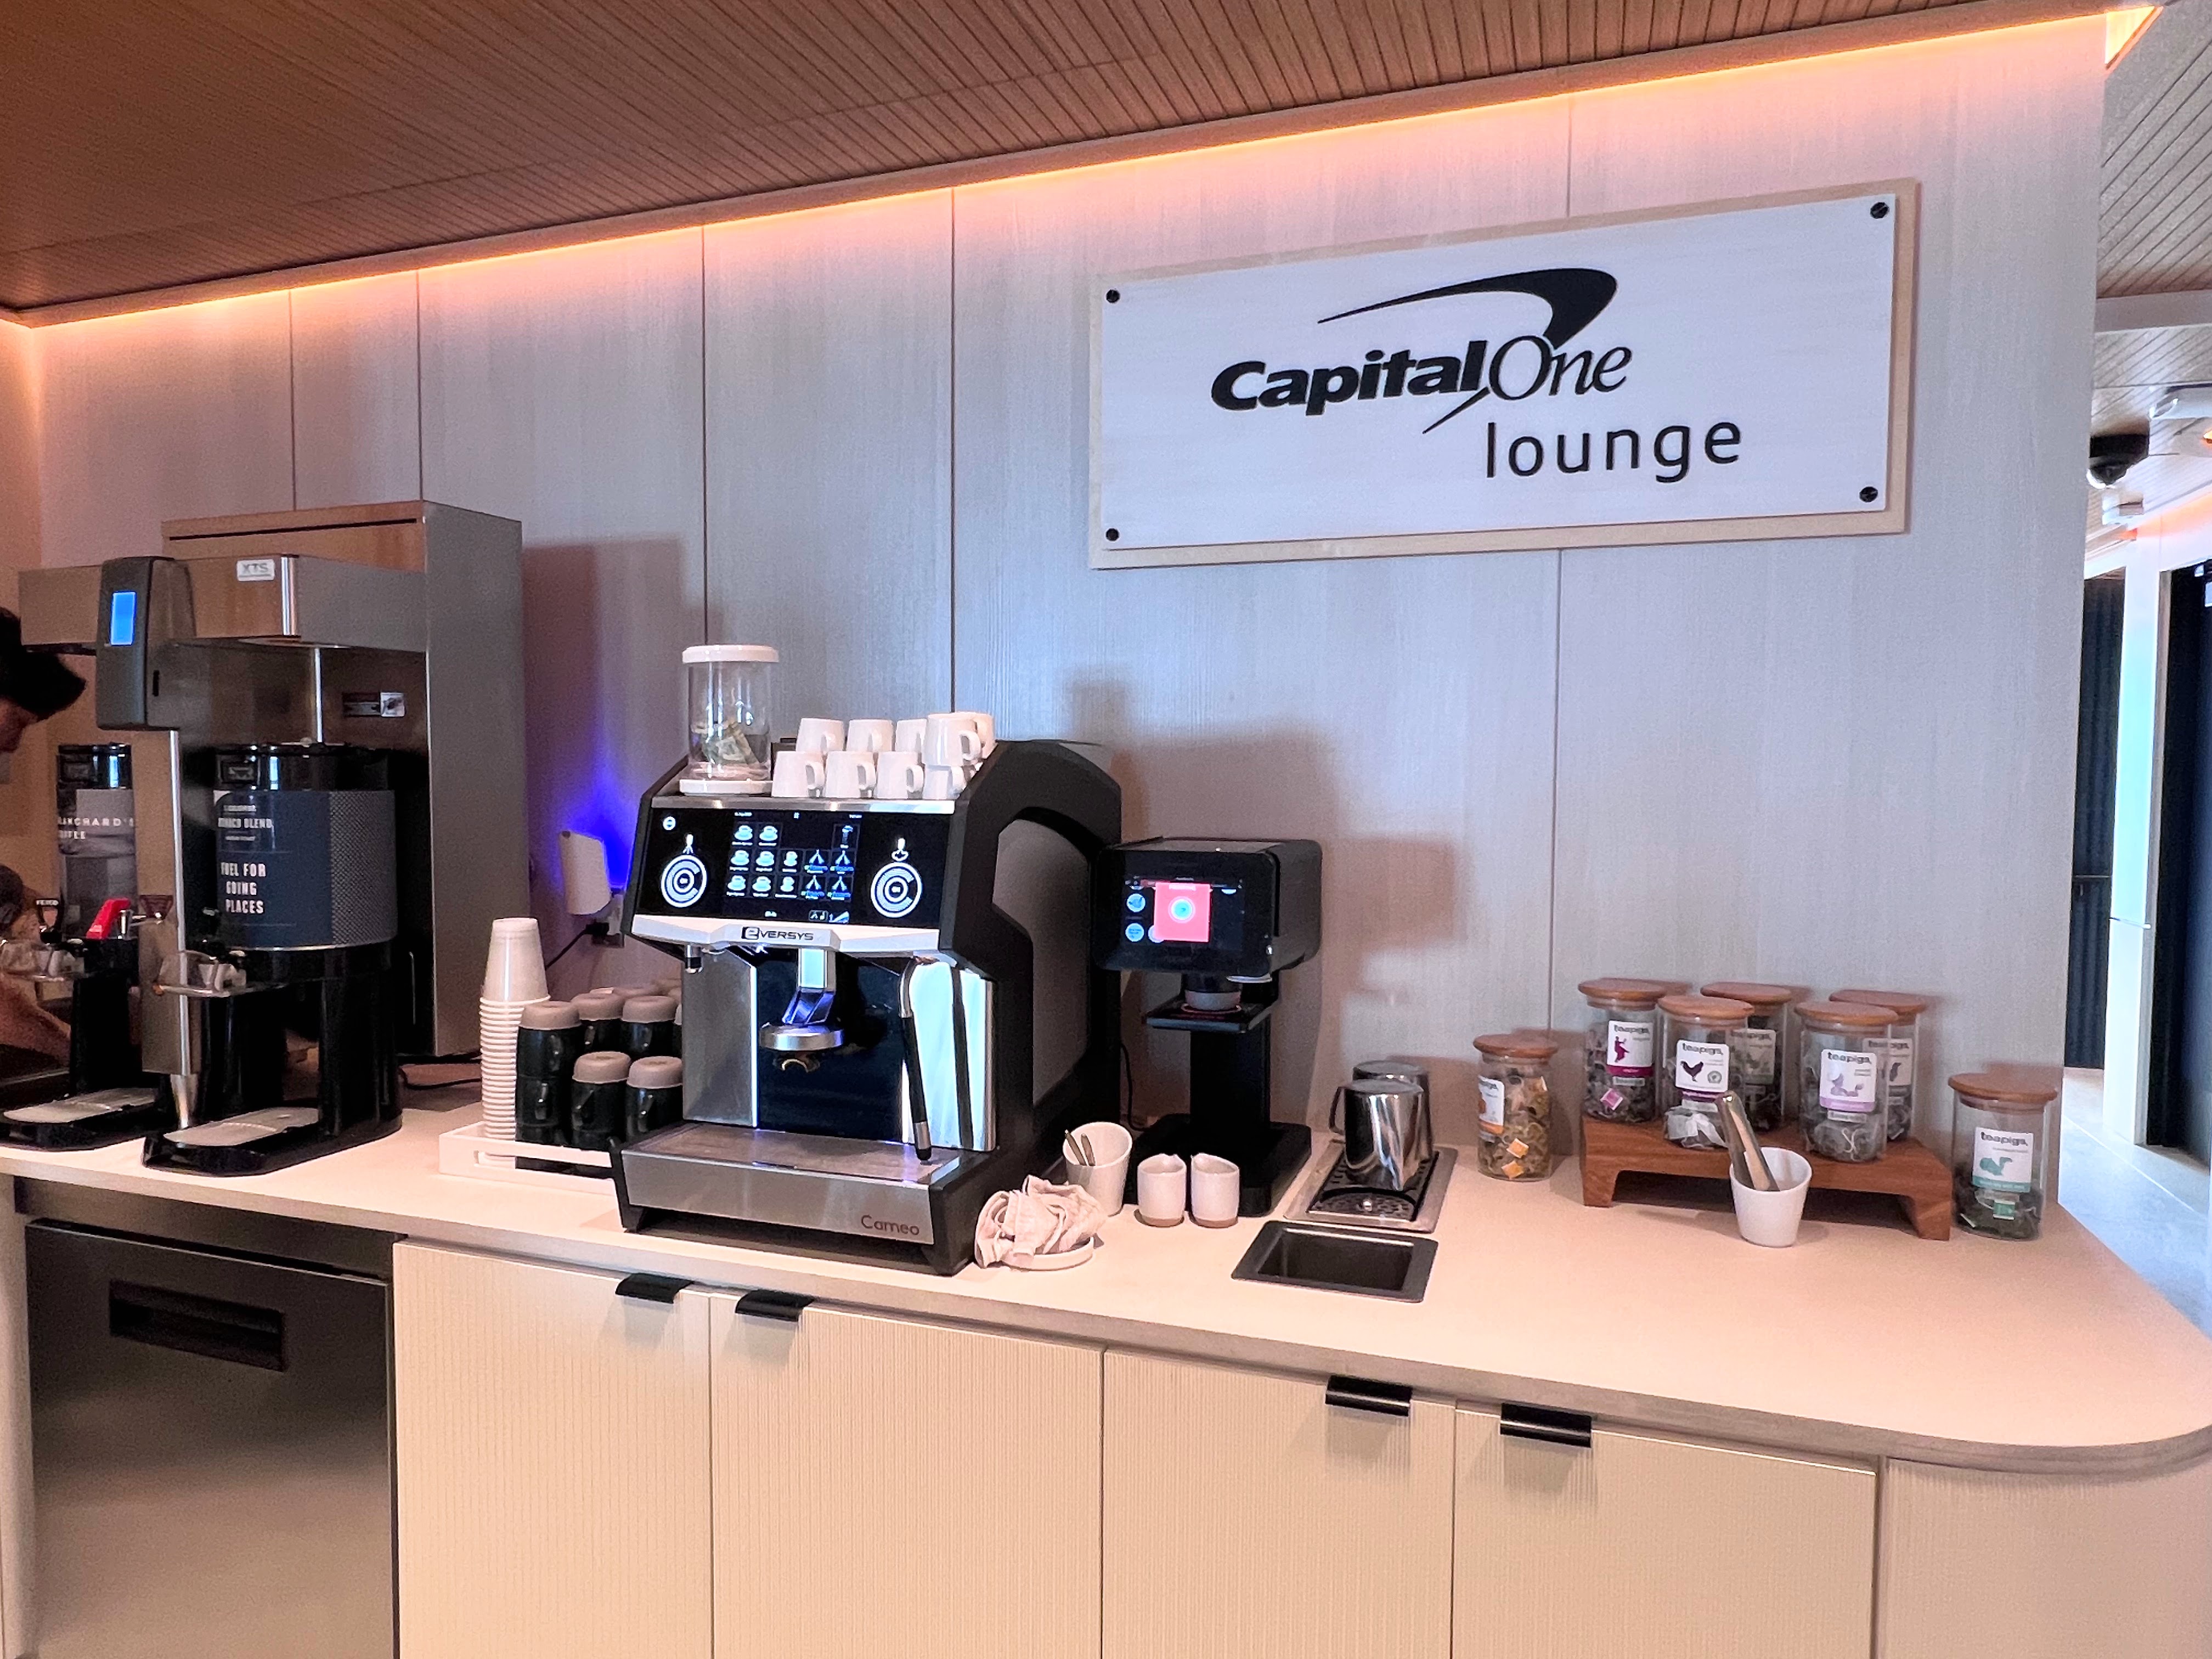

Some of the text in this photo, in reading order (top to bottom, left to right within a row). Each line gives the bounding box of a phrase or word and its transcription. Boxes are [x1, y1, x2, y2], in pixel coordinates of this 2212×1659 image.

[1485, 421, 1741, 484] lounge
[242, 563, 269, 574] XTS
[243, 863, 267, 877] FOR
[226, 881, 257, 895] GOING
[225, 899, 264, 915] PLACES
[860, 1214, 919, 1235] Cameo
